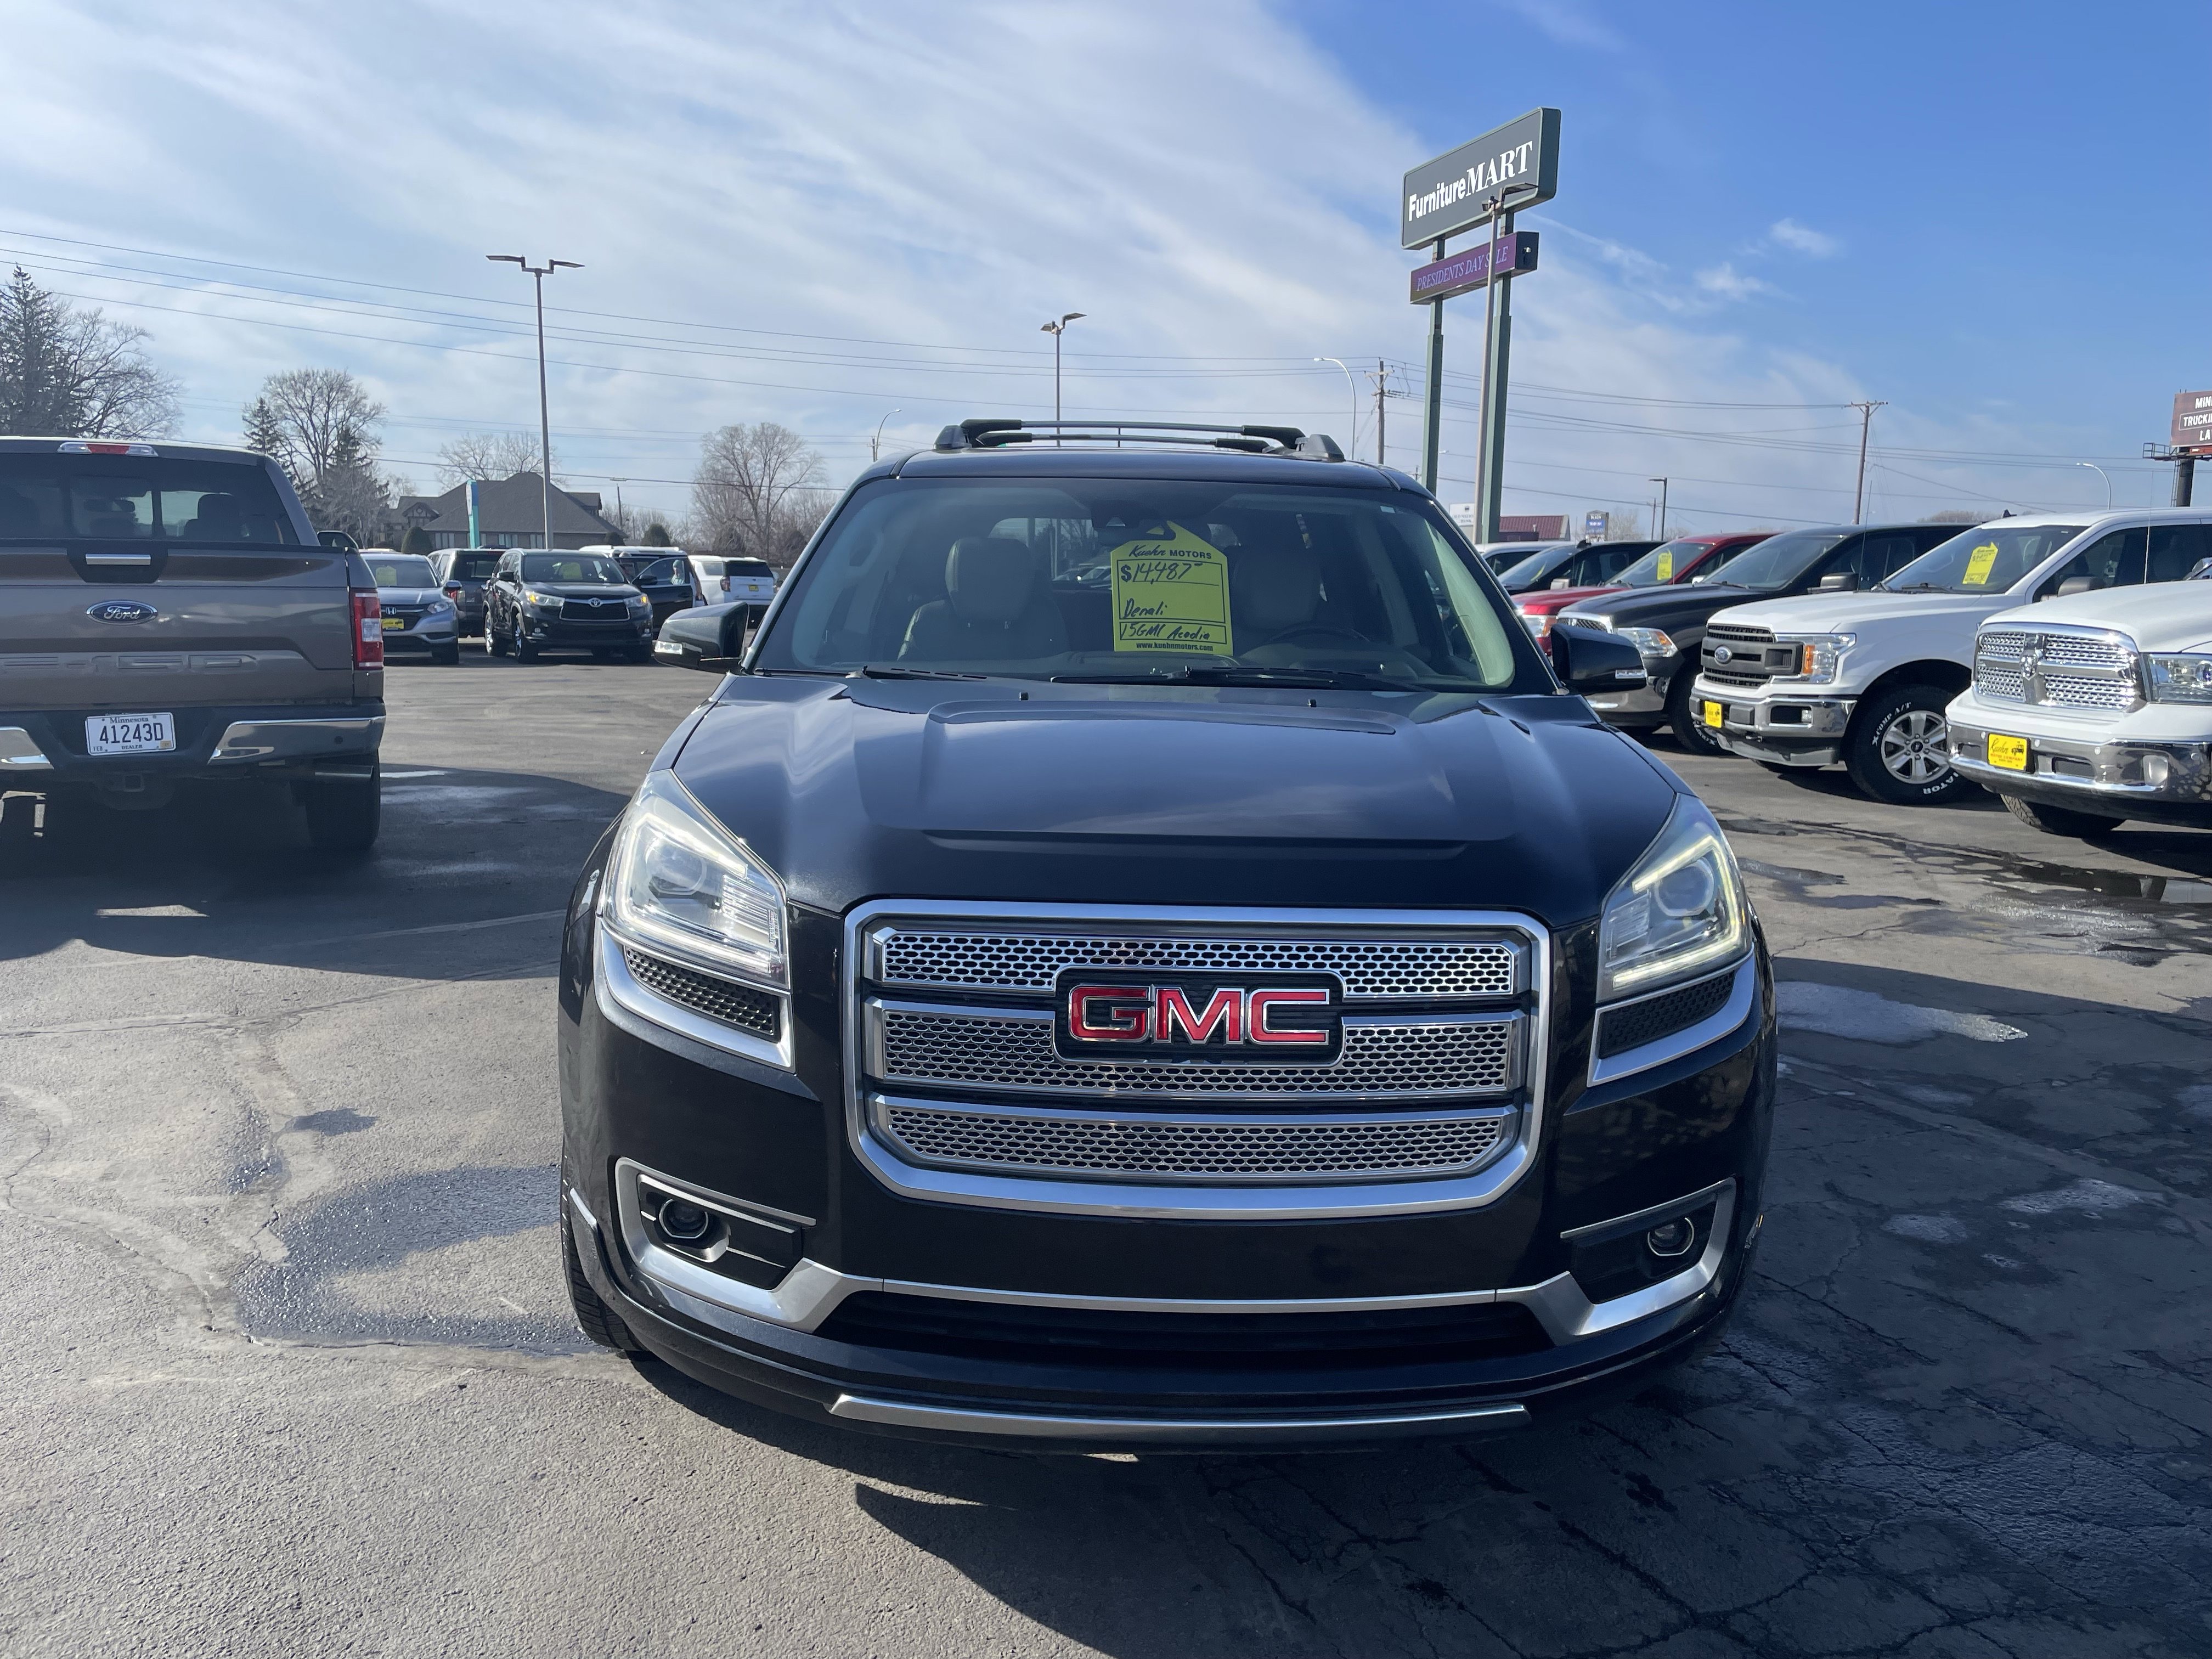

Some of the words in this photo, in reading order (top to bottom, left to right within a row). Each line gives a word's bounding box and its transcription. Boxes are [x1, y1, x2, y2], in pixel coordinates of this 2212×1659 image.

[1416, 262, 1465, 291] PRESIDENTS
[1465, 254, 1485, 275] DAY
[1485, 246, 1508, 268] SLE
[2195, 396, 2212, 409] MIN
[2199, 429, 2212, 441] LA
[1129, 545, 1166, 557] Kuehn
[1170, 550, 1212, 559] MOTORS
[104, 606, 140, 619] Ford
[1123, 598, 1167, 618] Denali
[1167, 625, 1210, 640] Acadia
[1136, 642, 1214, 651] www.kuehnmotors.com
[99, 723, 163, 744] 41243D
[1923, 772, 1959, 794] IATOR
[1068, 984, 1330, 1046] GMC
